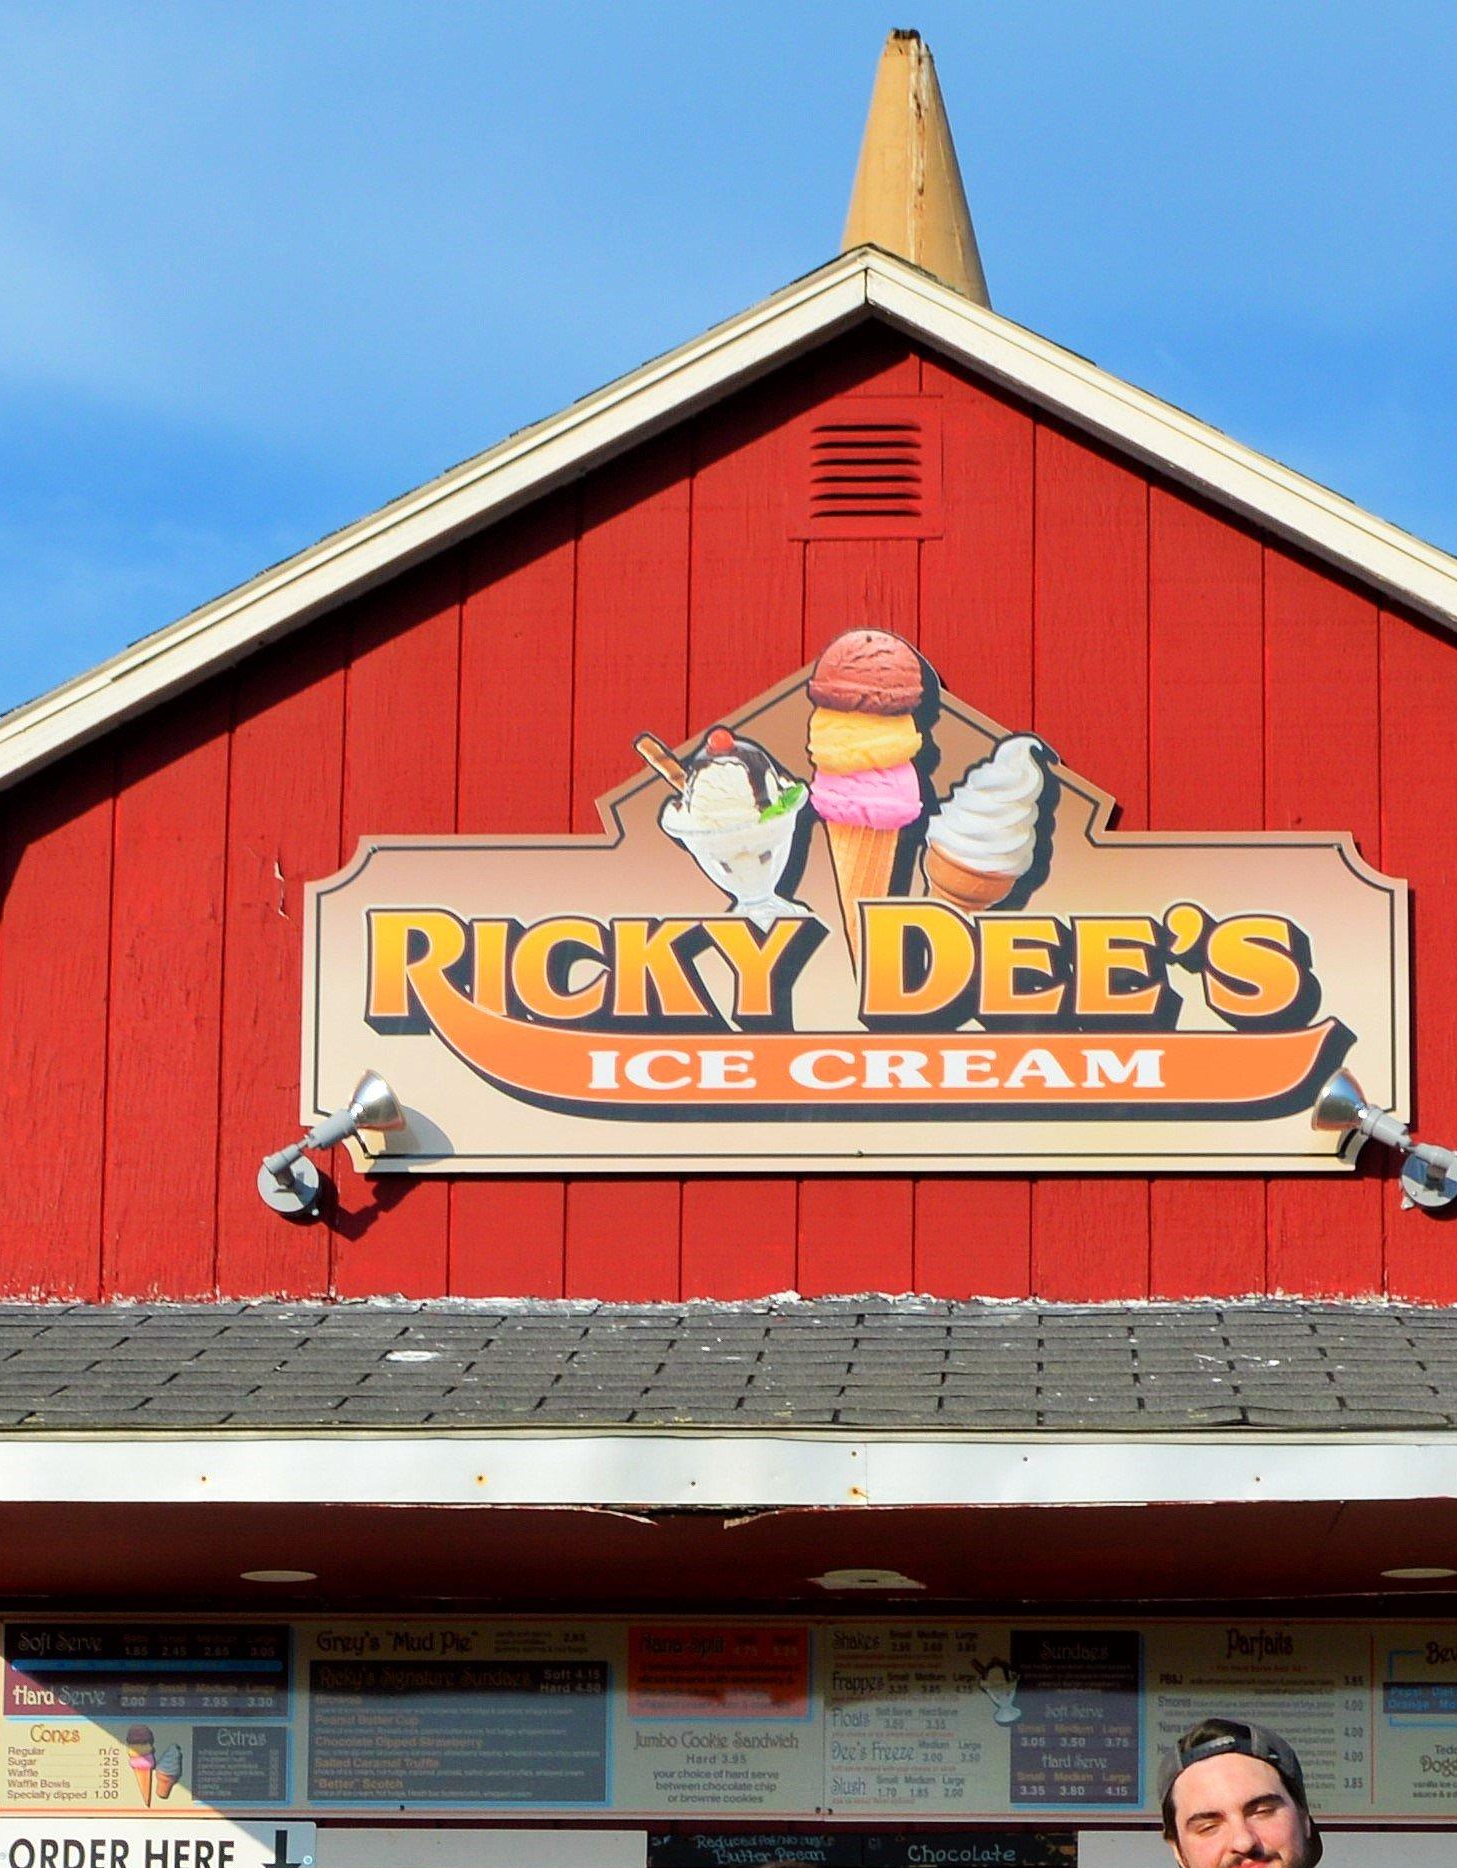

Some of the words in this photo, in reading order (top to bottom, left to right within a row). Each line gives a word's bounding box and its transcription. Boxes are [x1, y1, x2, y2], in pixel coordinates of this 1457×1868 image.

[367, 905, 827, 1033] RICKY
[858, 900, 1320, 1030] DEE'S
[589, 1049, 757, 1091] ICE
[788, 1048, 1167, 1091] CREAM
[18, 1632, 50, 1653] Soft
[58, 1632, 103, 1653] Serve
[833, 1631, 880, 1650] Shakes
[1225, 1627, 1295, 1661] Parfaits
[1040, 1641, 1110, 1663] Sundaes
[13, 1684, 53, 1706] Hard
[59, 1684, 106, 1707] Serve
[540, 1684, 570, 1693] Hard
[1044, 1703, 1068, 1721] Soft
[1071, 1704, 1104, 1718] Serve
[30, 1723, 81, 1744] Cones
[216, 1729, 267, 1748] Extras
[315, 1736, 374, 1747] Chocolate
[634, 1731, 677, 1750] Jumbo
[682, 1731, 727, 1749] Cookie
[733, 1731, 799, 1749] Sandwich
[1021, 1737, 1046, 1748] 3.05
[1059, 1737, 1086, 1748] 3.50
[1104, 1737, 1129, 1748] 3.75
[8, 1746, 45, 1760] Regular
[99, 1746, 120, 1757] n/c
[686, 1755, 717, 1764] Hard
[1042, 1753, 1071, 1768] Hard
[1074, 1754, 1108, 1769] Serve
[8, 1757, 37, 1768] Sugar
[99, 1757, 120, 1767] .25
[8, 1768, 39, 1777] Waffle
[99, 1768, 120, 1778] .55
[653, 1770, 677, 1780] your
[678, 1769, 712, 1779] choice
[713, 1769, 725, 1779] of
[725, 1769, 750, 1779] hard
[751, 1770, 779, 1779] serve
[8, 1779, 38, 1788] Waffle
[40, 1779, 71, 1788] Bowls
[99, 1779, 119, 1789] .55
[362, 1778, 403, 1789] Scotch
[655, 1782, 701, 1791] between
[702, 1781, 752, 1791] chocolate
[754, 1781, 777, 1793] chip
[831, 1777, 866, 1796] Slush
[1020, 1785, 1046, 1796] 3.35
[1104, 1786, 1128, 1797] 4.15
[7, 1790, 50, 1801] Specialty
[53, 1790, 87, 1801] dipped
[95, 1790, 119, 1800] 1.00
[680, 1794, 721, 1803] brownie
[723, 1794, 763, 1804] cookies
[713, 1848, 771, 1864] Butter
[775, 1849, 826, 1861] Pecan
[908, 1842, 1017, 1864] Chocolate
